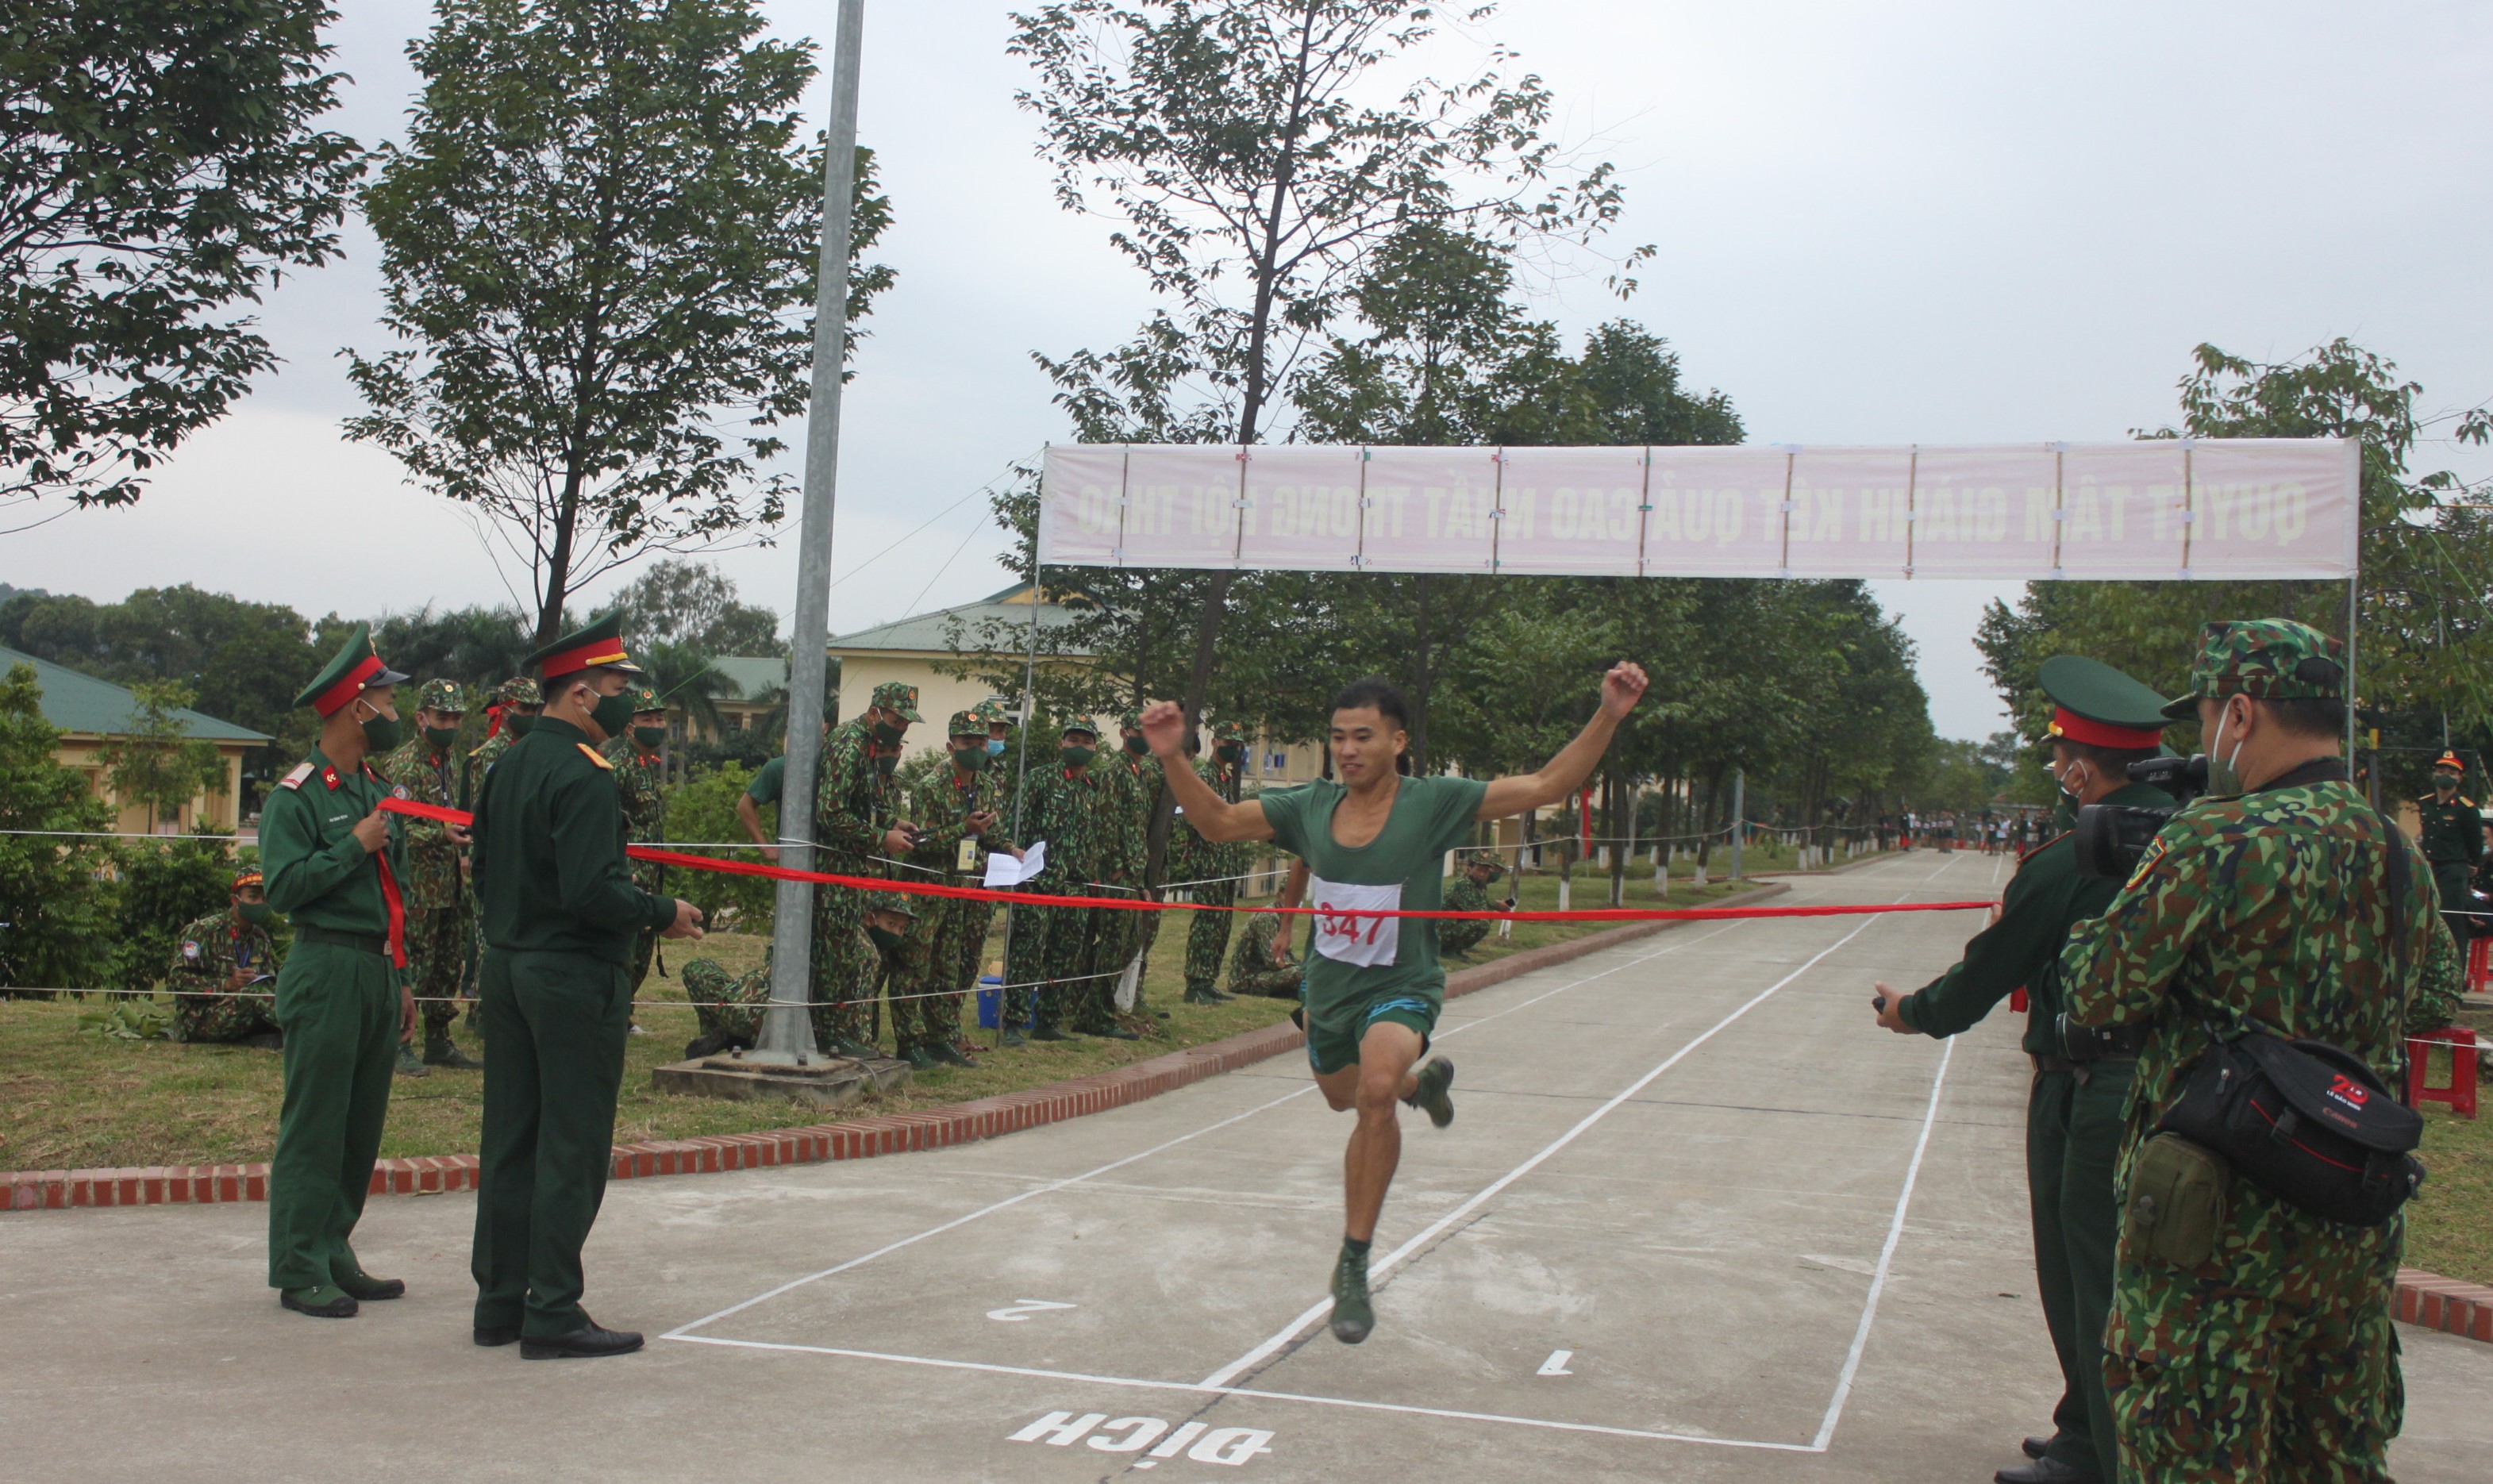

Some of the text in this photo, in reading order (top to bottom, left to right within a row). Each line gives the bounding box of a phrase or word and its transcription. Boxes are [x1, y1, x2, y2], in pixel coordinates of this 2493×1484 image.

[1321, 902, 1387, 945] 347
[2323, 1107, 2359, 1128] Canon
[986, 1299, 1077, 1321] 2
[1537, 1350, 1573, 1375] 1
[1005, 1410, 1275, 1468] ĐÍCH
